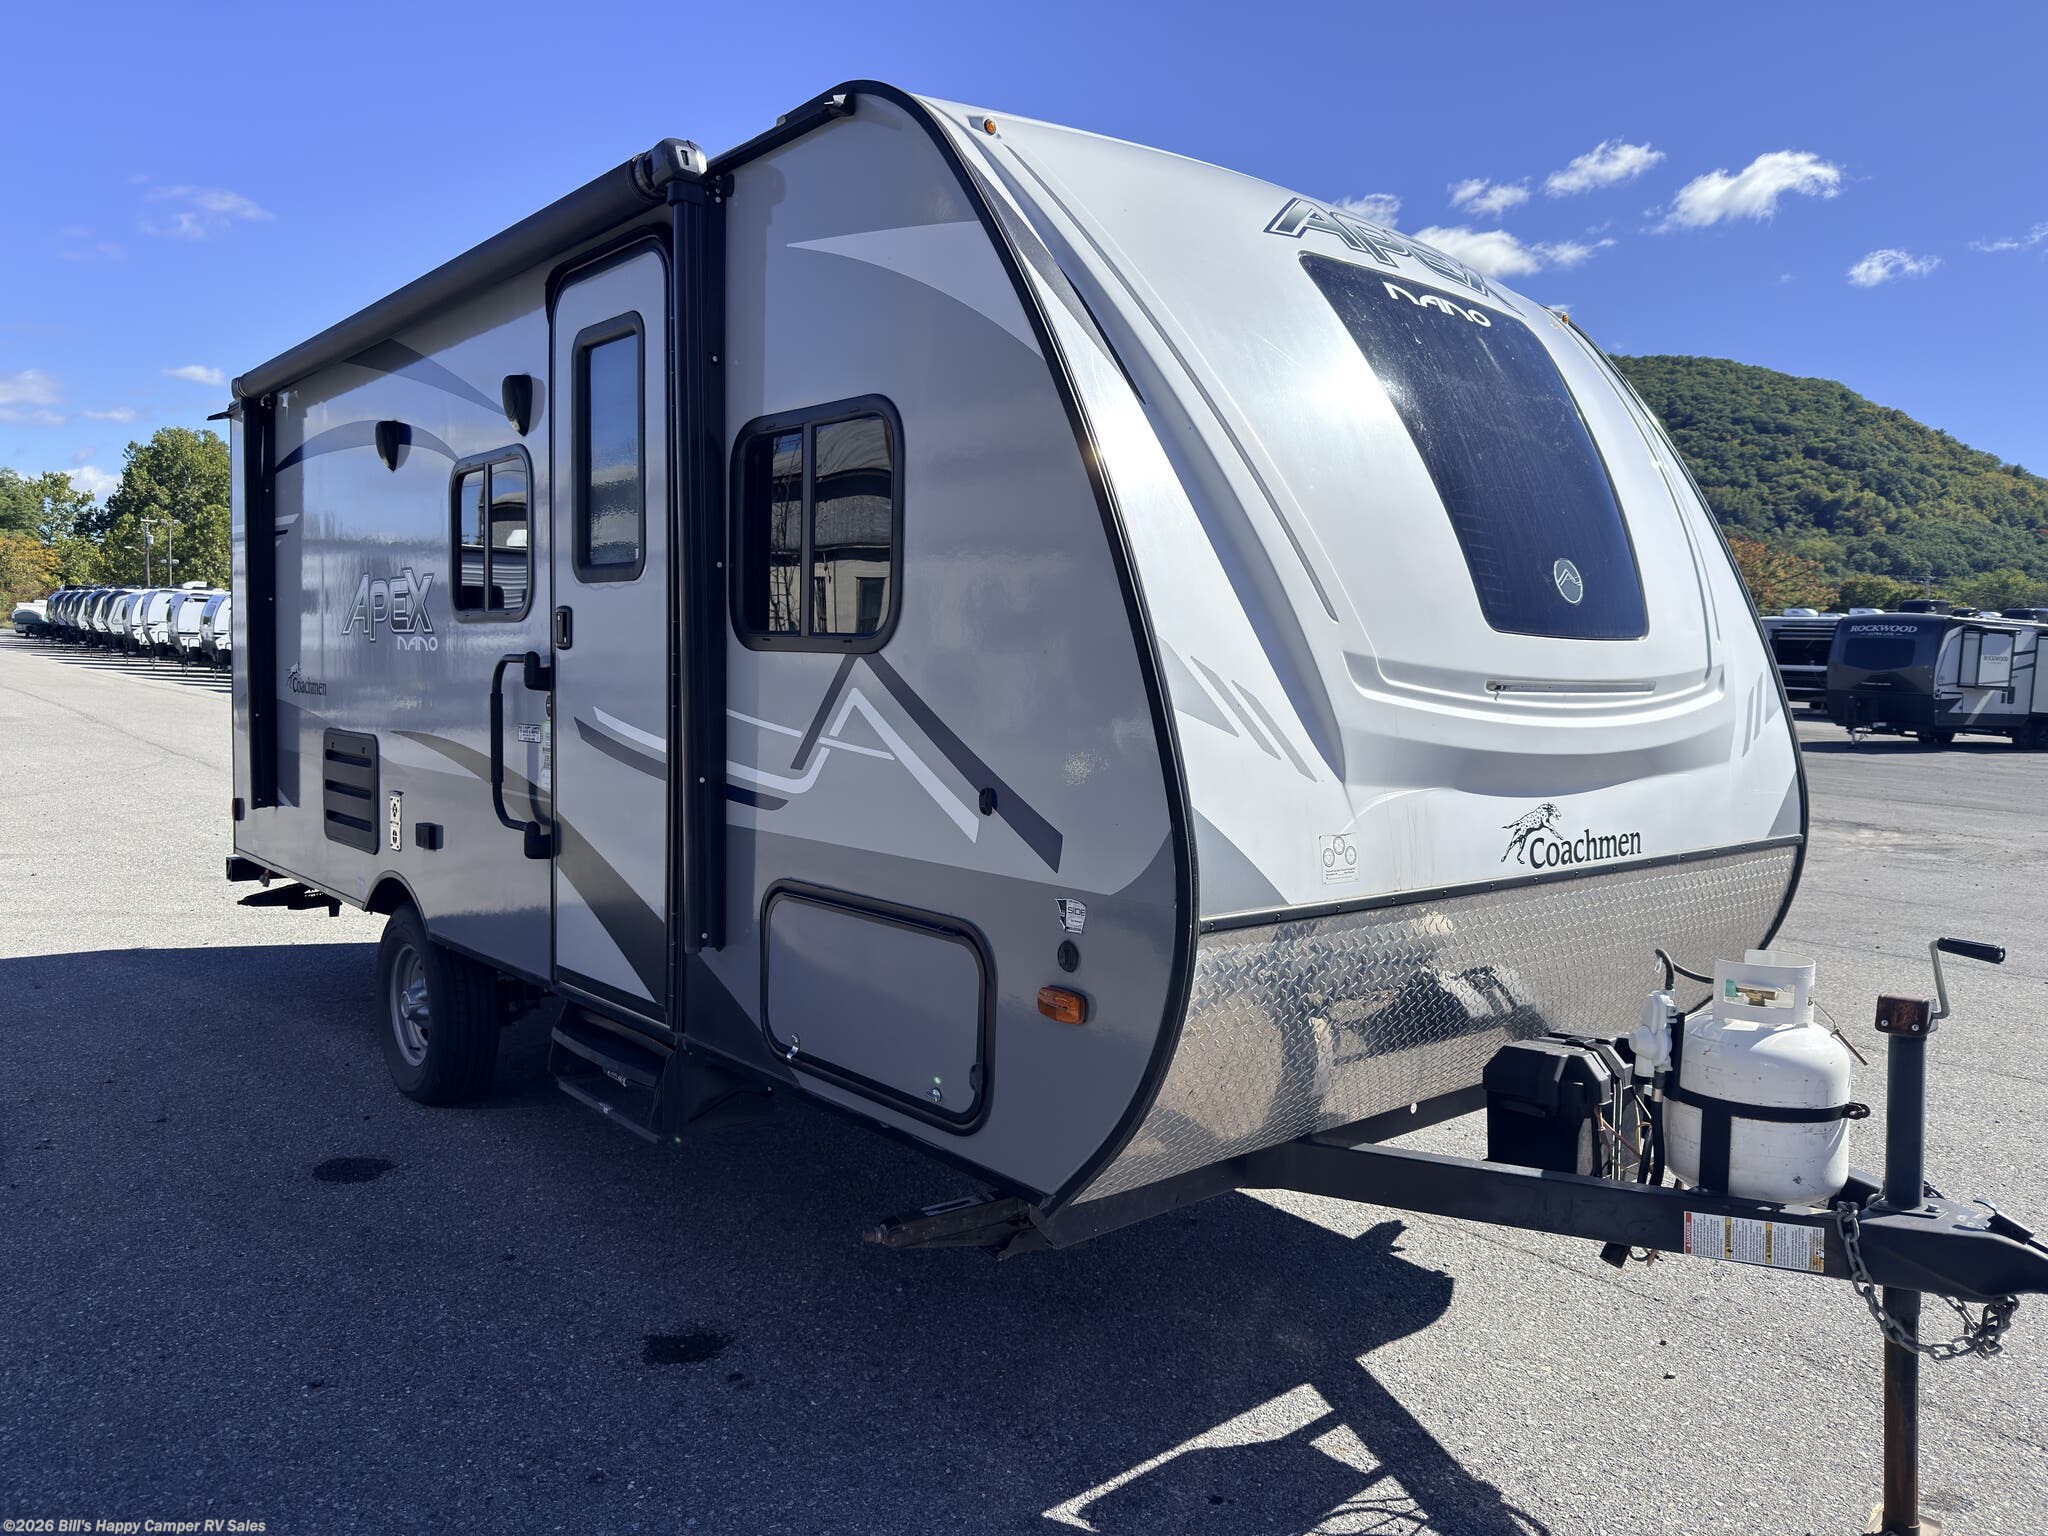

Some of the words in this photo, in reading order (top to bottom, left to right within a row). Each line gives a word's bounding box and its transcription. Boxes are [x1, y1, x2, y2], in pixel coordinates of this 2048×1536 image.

[341, 567, 434, 643] APEX
[1850, 624, 1918, 633] ROCKWOOD
[292, 676, 328, 697] Coachmen
[1529, 828, 1642, 870] Coachmen
